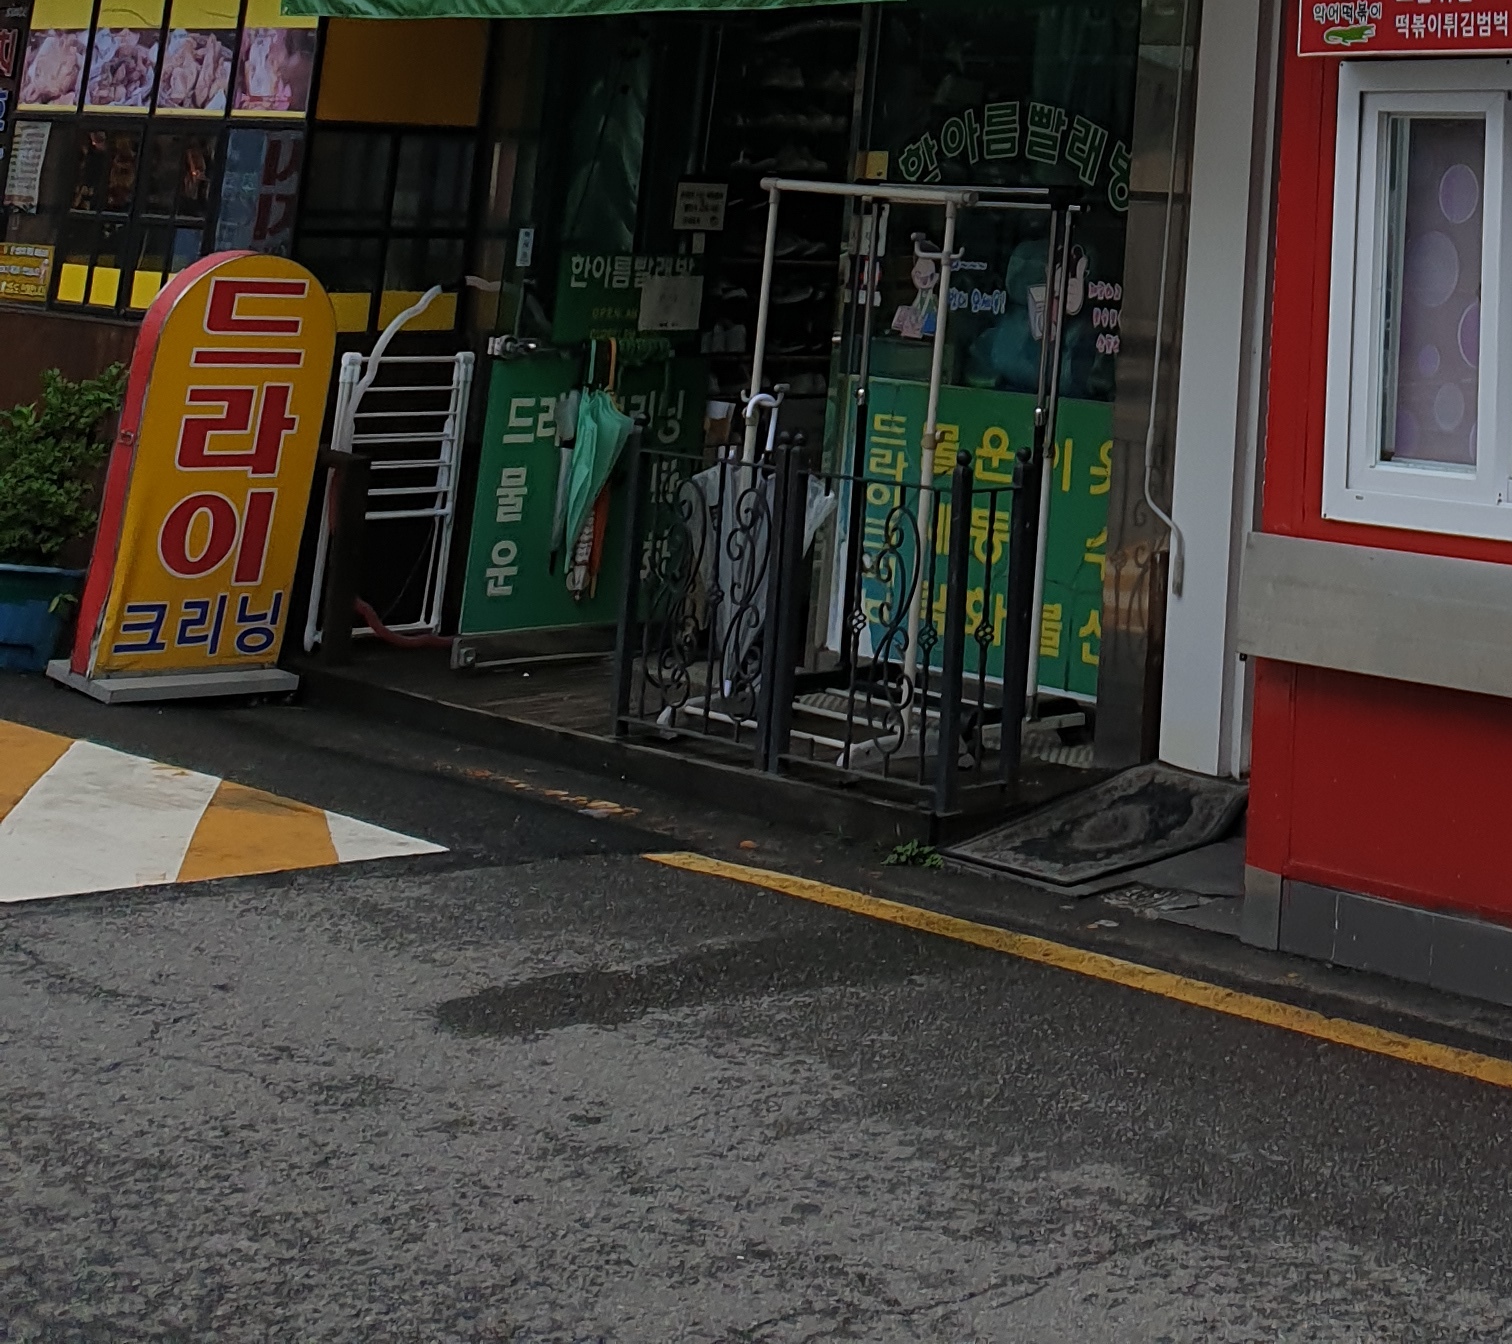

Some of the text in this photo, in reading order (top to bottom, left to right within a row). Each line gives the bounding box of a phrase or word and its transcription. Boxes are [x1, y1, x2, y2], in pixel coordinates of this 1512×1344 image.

[1395, 10, 1509, 39] 떡볶이튀김범벅
[157, 276, 311, 587] 드라이
[112, 590, 284, 657] 크리닝
